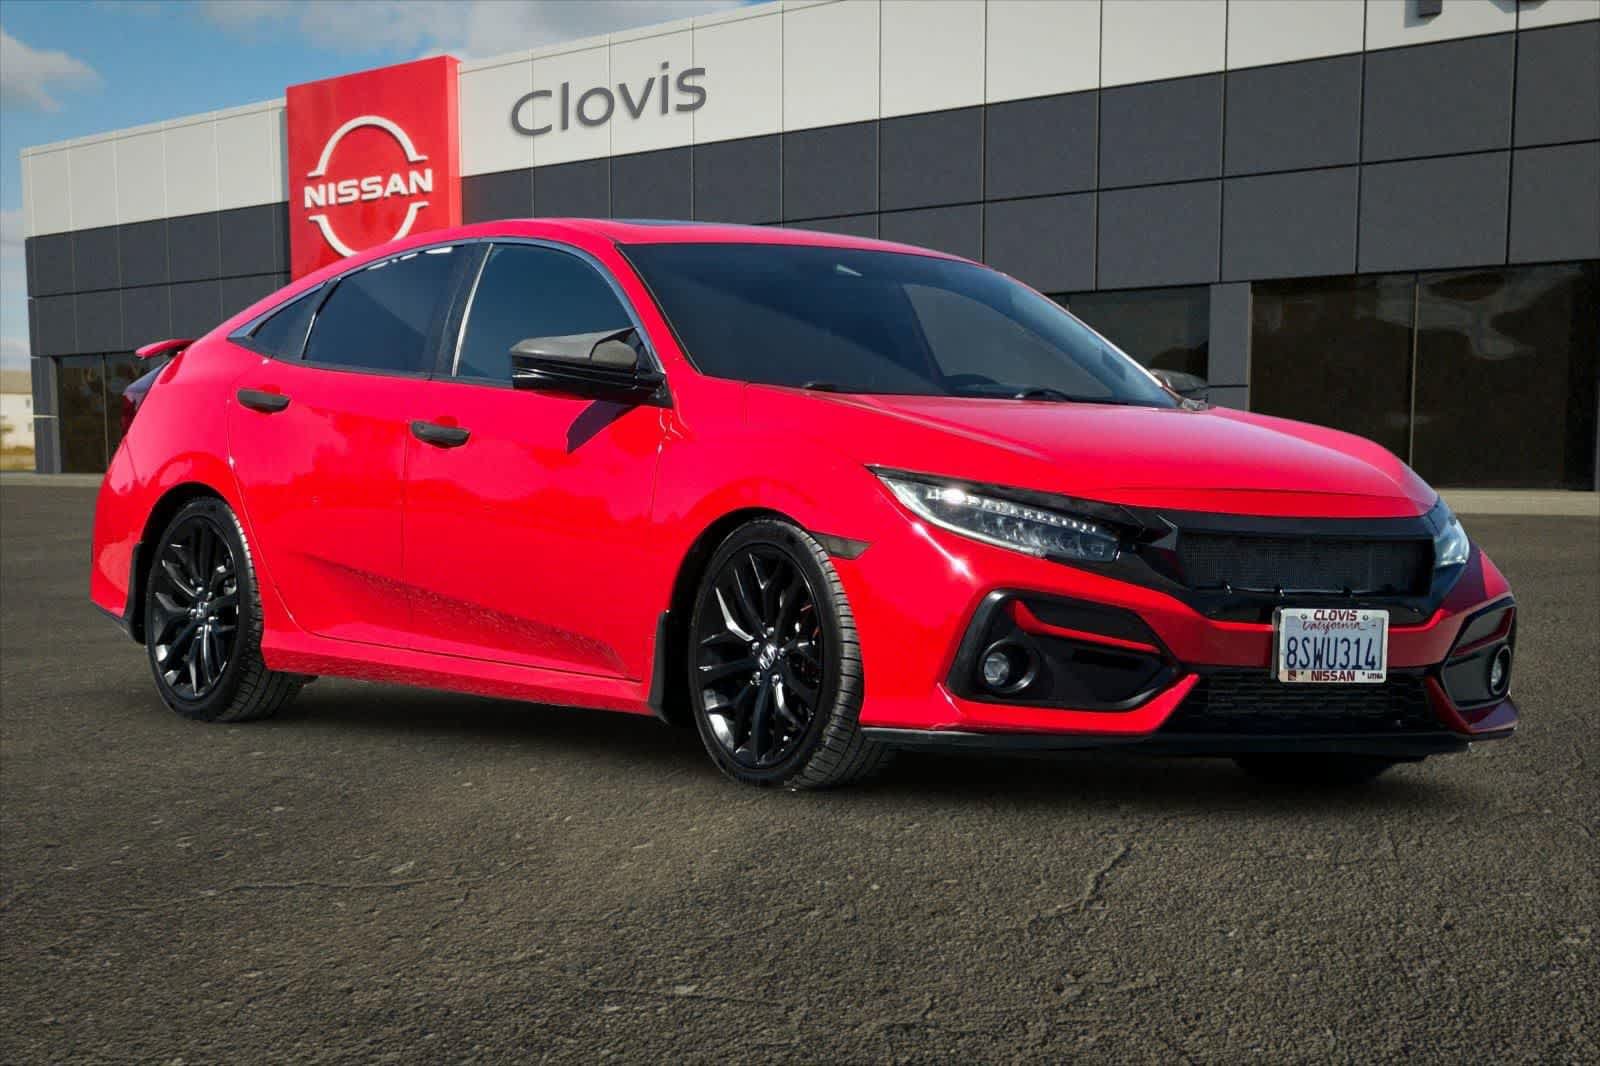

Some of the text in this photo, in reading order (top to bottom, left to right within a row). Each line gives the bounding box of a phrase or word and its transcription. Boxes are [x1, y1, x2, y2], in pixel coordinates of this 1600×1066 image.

[510, 61, 707, 136] Clovis
[304, 168, 433, 208] NISSAN
[1313, 609, 1358, 621] CLOVIS
[1302, 621, 1367, 634] California
[1286, 636, 1376, 670] 8SWU314
[1311, 670, 1356, 681] NISSAN
